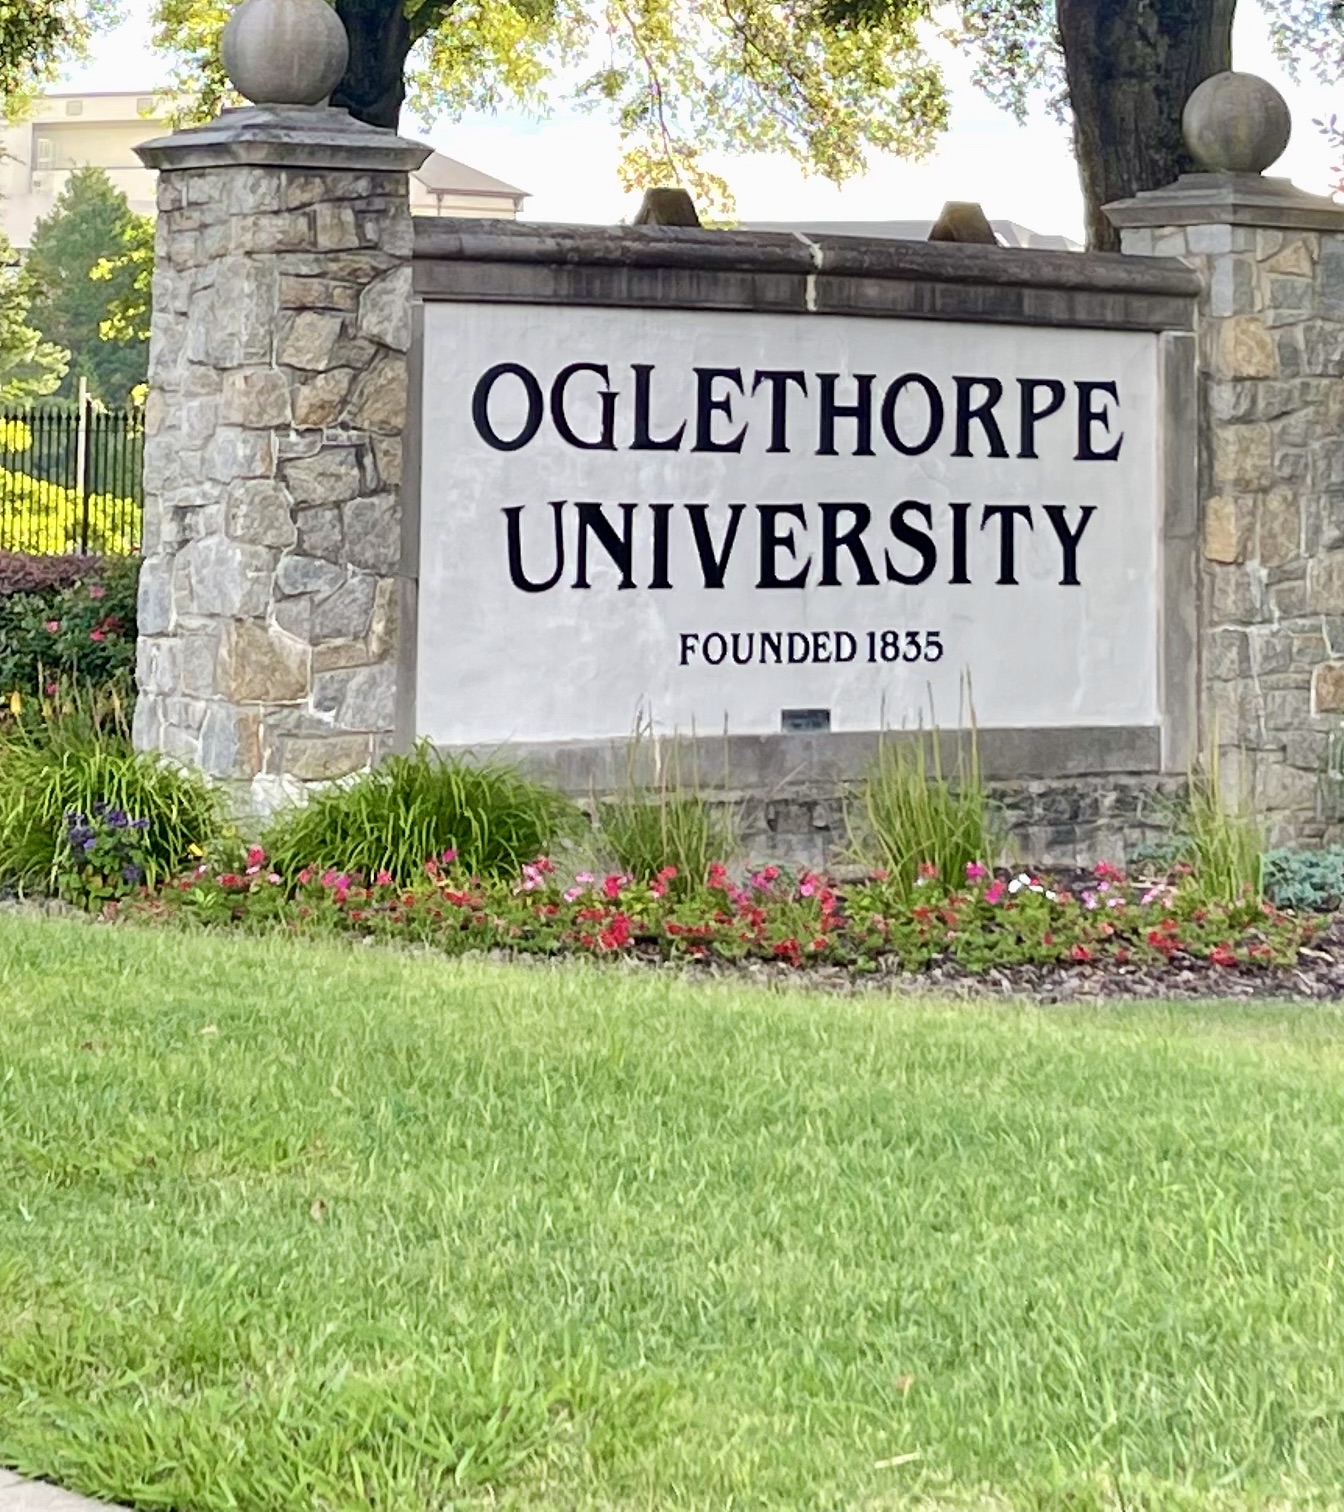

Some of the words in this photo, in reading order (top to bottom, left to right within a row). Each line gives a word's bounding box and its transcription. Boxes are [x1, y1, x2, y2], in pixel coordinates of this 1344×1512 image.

[472, 363, 1123, 461] OGLETHORPE
[502, 500, 1097, 593] UNIVERSITY
[681, 632, 856, 665] FOUNDED
[867, 631, 943, 662] 1835
